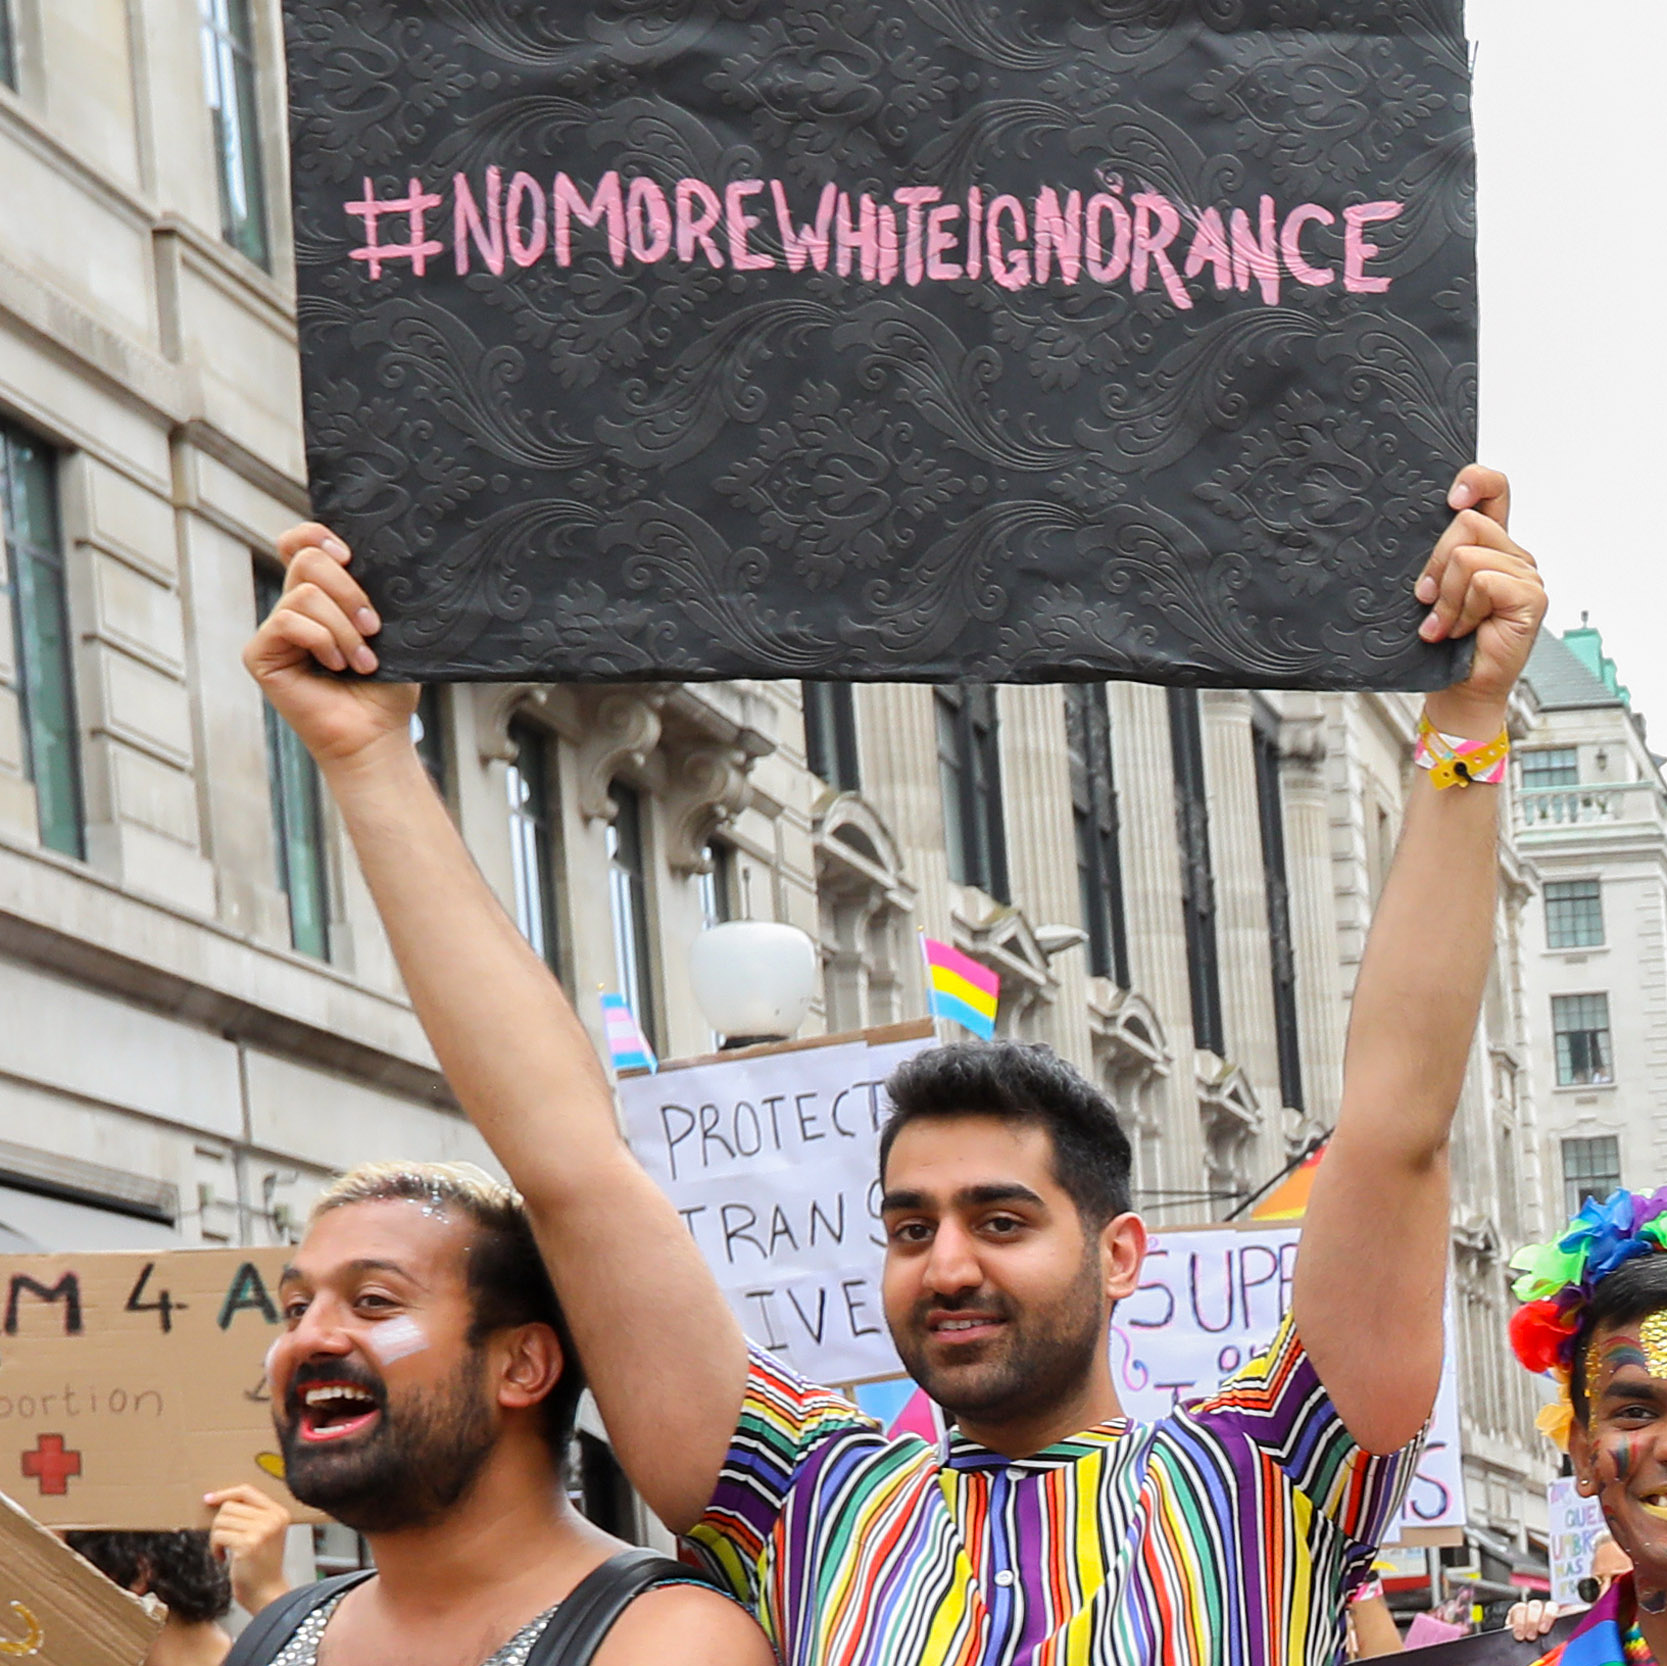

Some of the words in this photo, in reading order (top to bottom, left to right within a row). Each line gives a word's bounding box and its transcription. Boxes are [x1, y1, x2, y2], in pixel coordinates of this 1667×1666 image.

[343, 166, 1405, 311] #NOMOREWHITEIGNORANCE
[660, 1079, 887, 1180] PROTECT
[124, 1262, 189, 1334] 4
